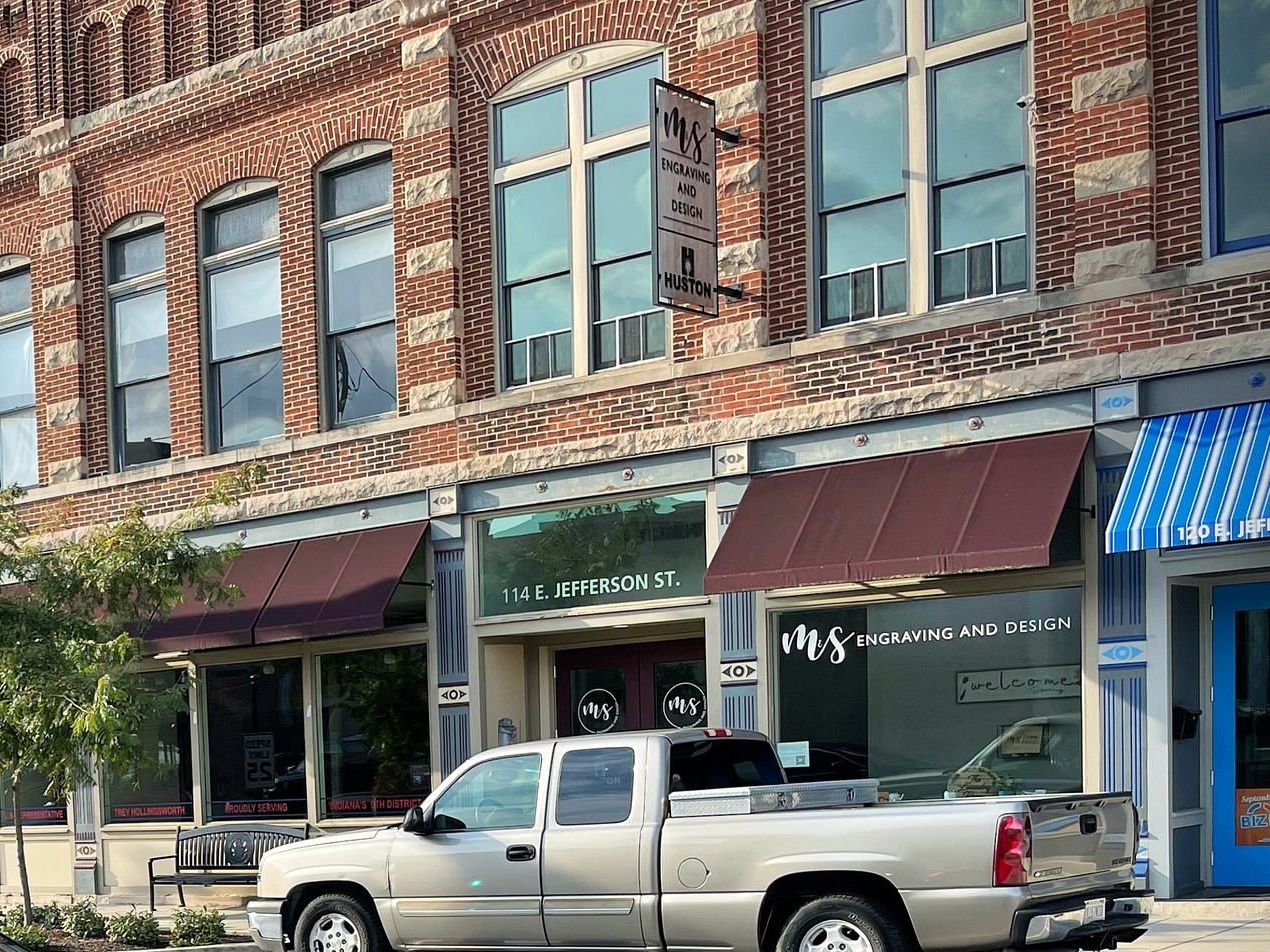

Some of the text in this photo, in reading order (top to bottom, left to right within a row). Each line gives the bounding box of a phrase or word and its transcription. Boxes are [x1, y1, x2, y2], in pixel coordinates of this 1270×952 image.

[661, 157, 711, 185] ENGRAVING
[677, 181, 697, 198] AND
[671, 199, 703, 220] DESIGN
[664, 271, 712, 299] HUSTON
[1177, 524, 1210, 541] 120
[1214, 523, 1231, 537] E.
[502, 570, 680, 604] 114 E. JEFFERSON ST.
[856, 616, 1071, 647] ENGRAVING AND DESIGN
[114, 805, 186, 817] TREY HOLLINGSWORTH
[224, 802, 288, 814] PROUDLY SERVING
[330, 800, 367, 811] INDIANA'S
[1240, 814, 1268, 829] BIZ
